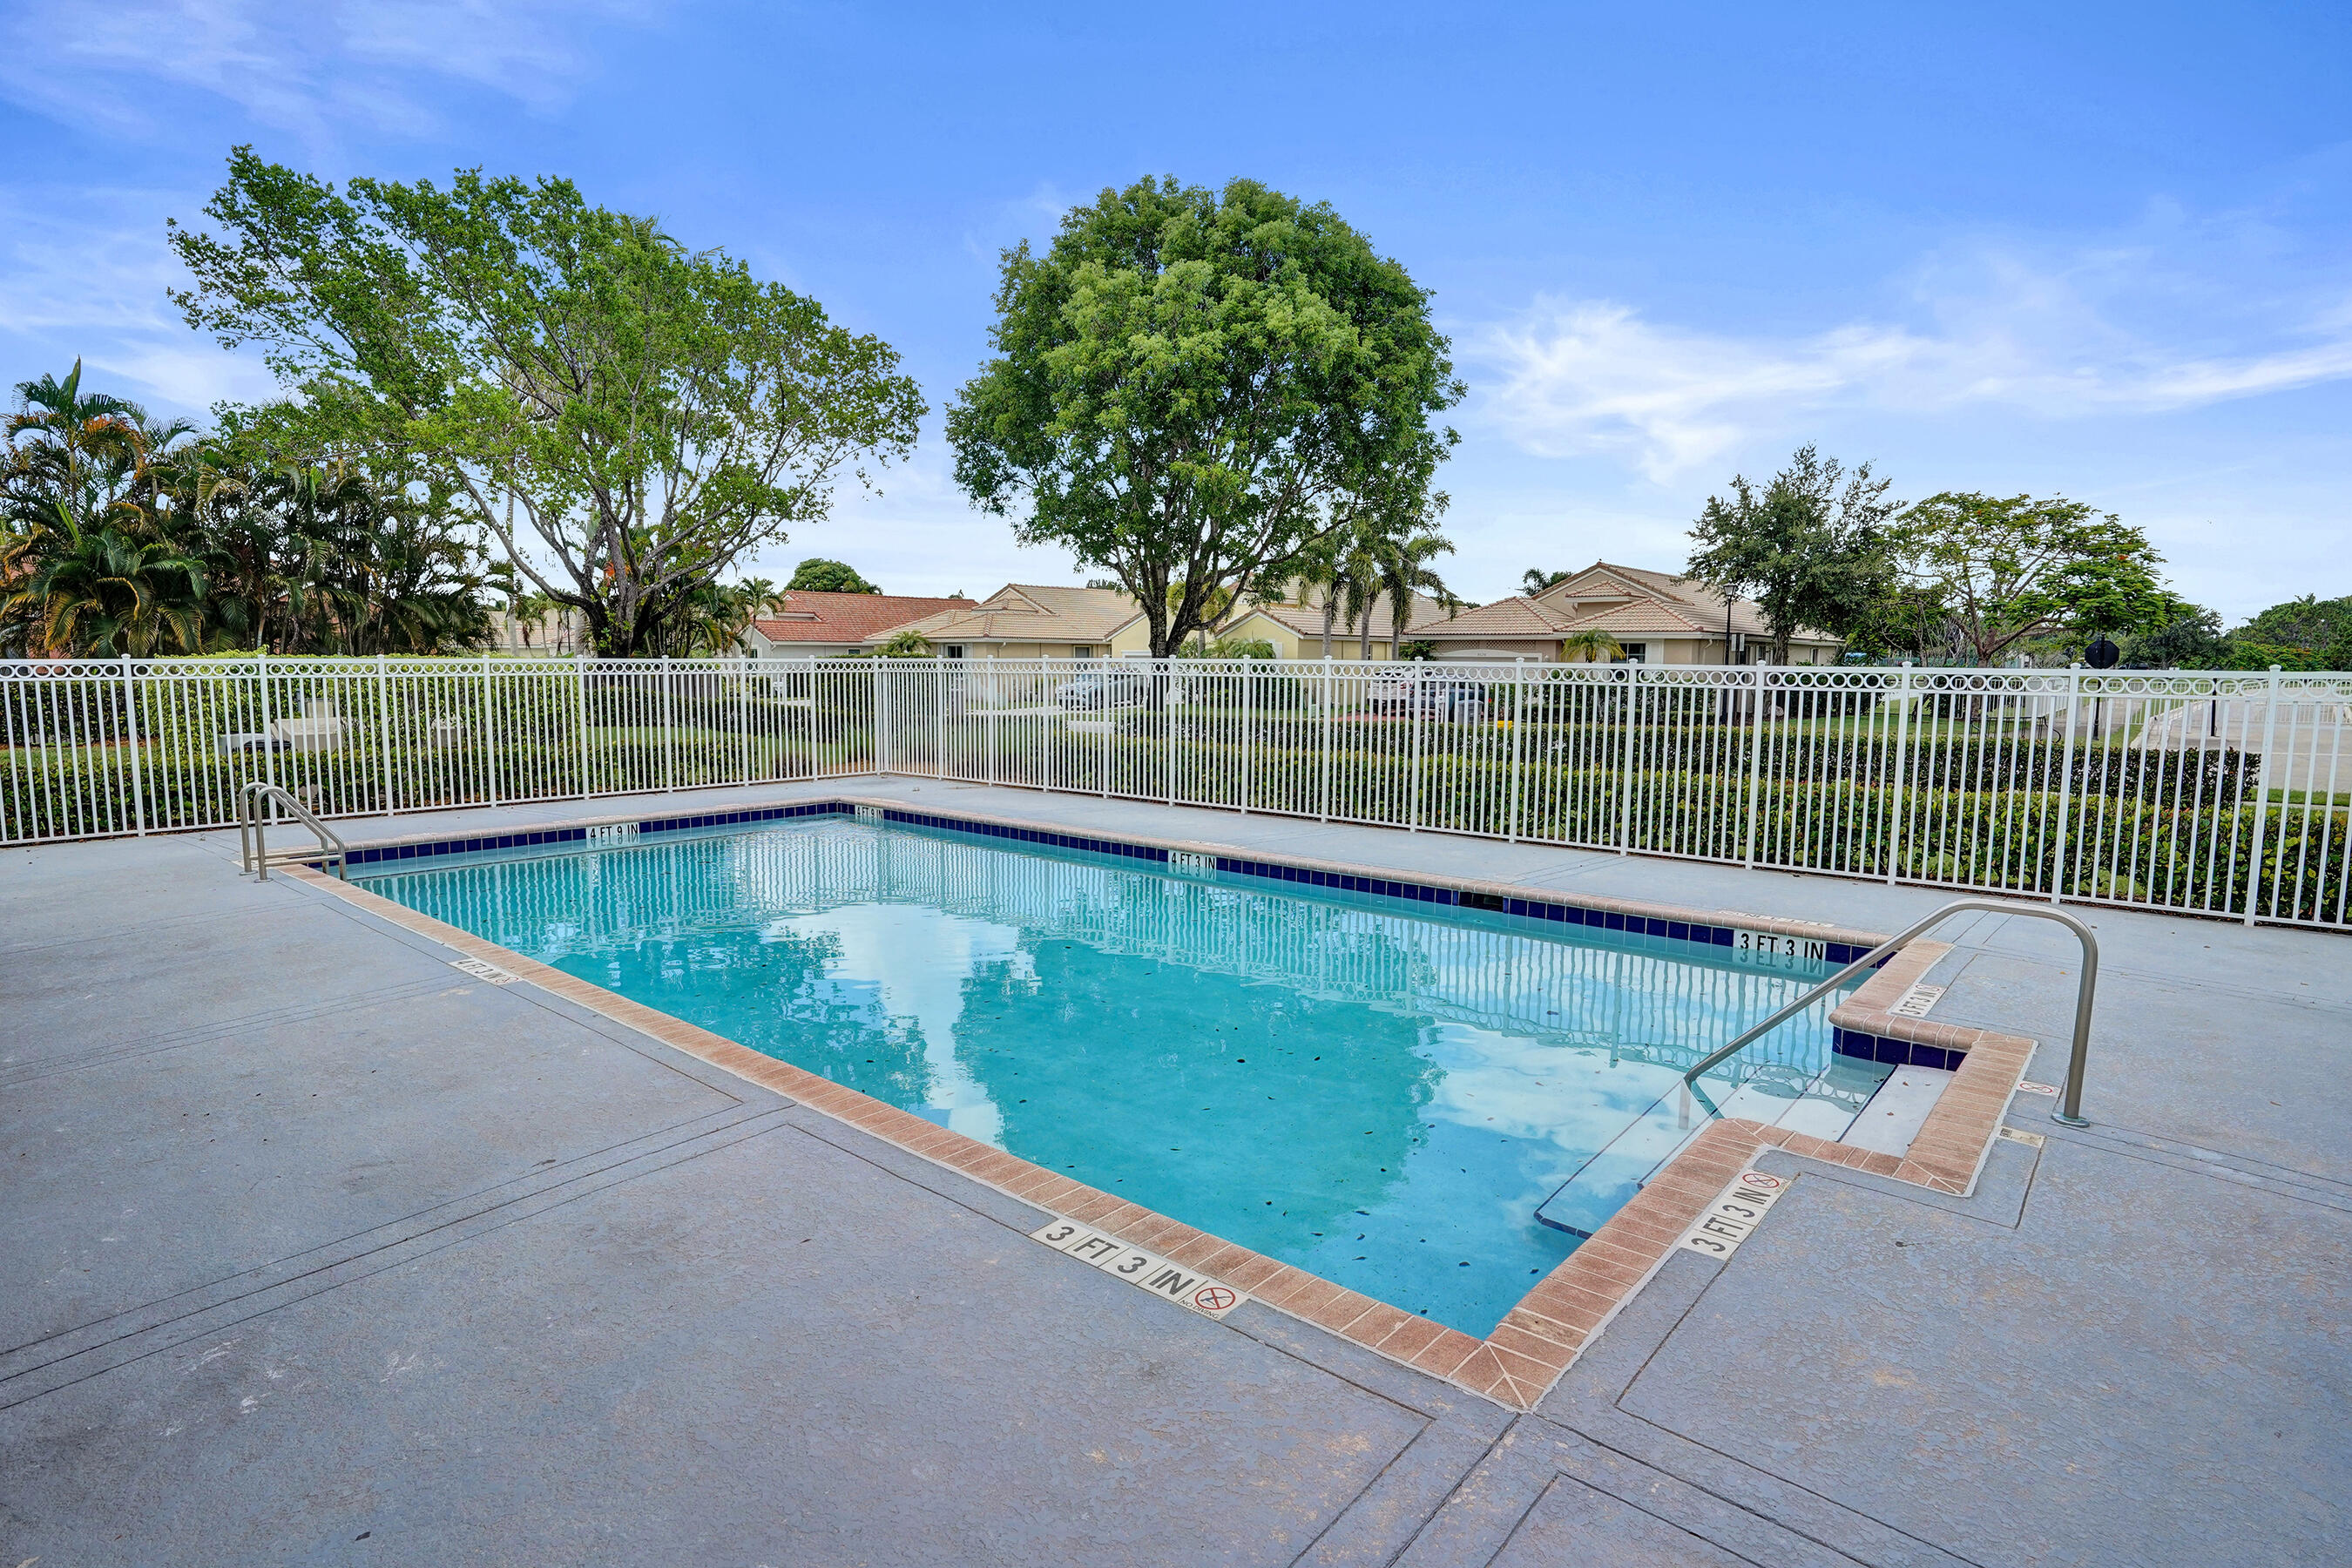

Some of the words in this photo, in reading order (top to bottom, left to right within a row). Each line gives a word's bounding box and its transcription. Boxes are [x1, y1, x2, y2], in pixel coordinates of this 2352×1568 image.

[590, 828, 596, 838] 4
[600, 826, 612, 837] FT
[617, 825, 623, 836] 9
[627, 824, 638, 835] IN
[1172, 852, 1177, 863] 4
[1180, 853, 1192, 866] FT
[1195, 855, 1200, 868] 3
[1205, 856, 1215, 869] IN
[1740, 933, 1749, 950] 3
[1757, 935, 1778, 953] FT
[1785, 939, 1794, 956] 3
[1804, 941, 1824, 960] IN
[1903, 1001, 1928, 1010] FT
[1732, 1186, 1771, 1205] IN
[1722, 1204, 1755, 1218] 3
[1702, 1216, 1744, 1238] FT
[1691, 1238, 1726, 1252] 3
[1045, 1226, 1075, 1241] 3
[1073, 1237, 1119, 1260] FT
[1118, 1256, 1147, 1274] 3
[1148, 1269, 1195, 1295] IN
[1193, 1305, 1220, 1319] DIVING
